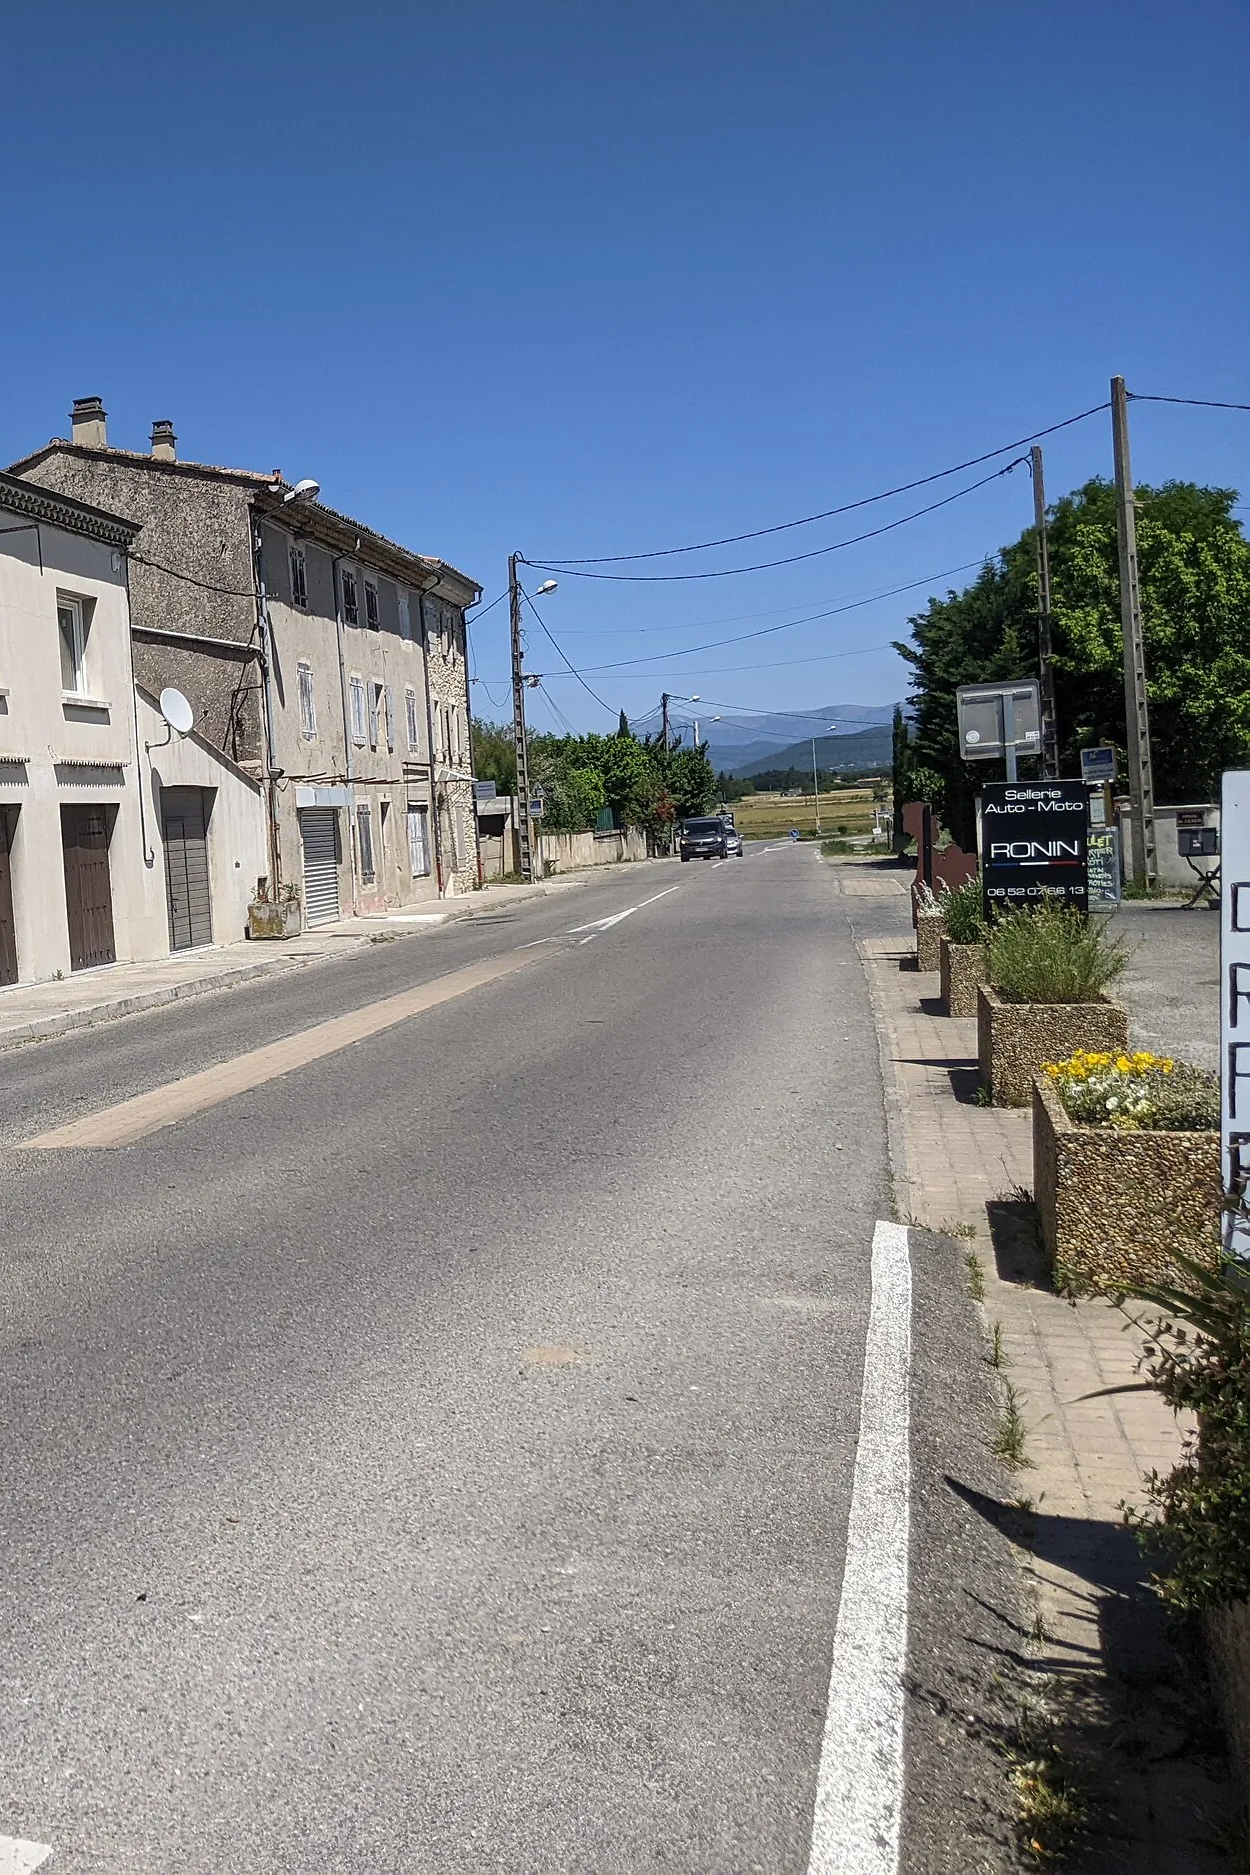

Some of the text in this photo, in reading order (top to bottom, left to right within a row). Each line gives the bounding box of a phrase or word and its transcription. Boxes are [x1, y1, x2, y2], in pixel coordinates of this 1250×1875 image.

[1004, 788, 1062, 801] Sellerie
[984, 803, 1025, 814] Auto
[1037, 800, 1084, 812] Moto
[1086, 834, 1113, 848] ULET
[990, 840, 1079, 859] RONIN
[987, 886, 1085, 897] 06 52 07 66 13
